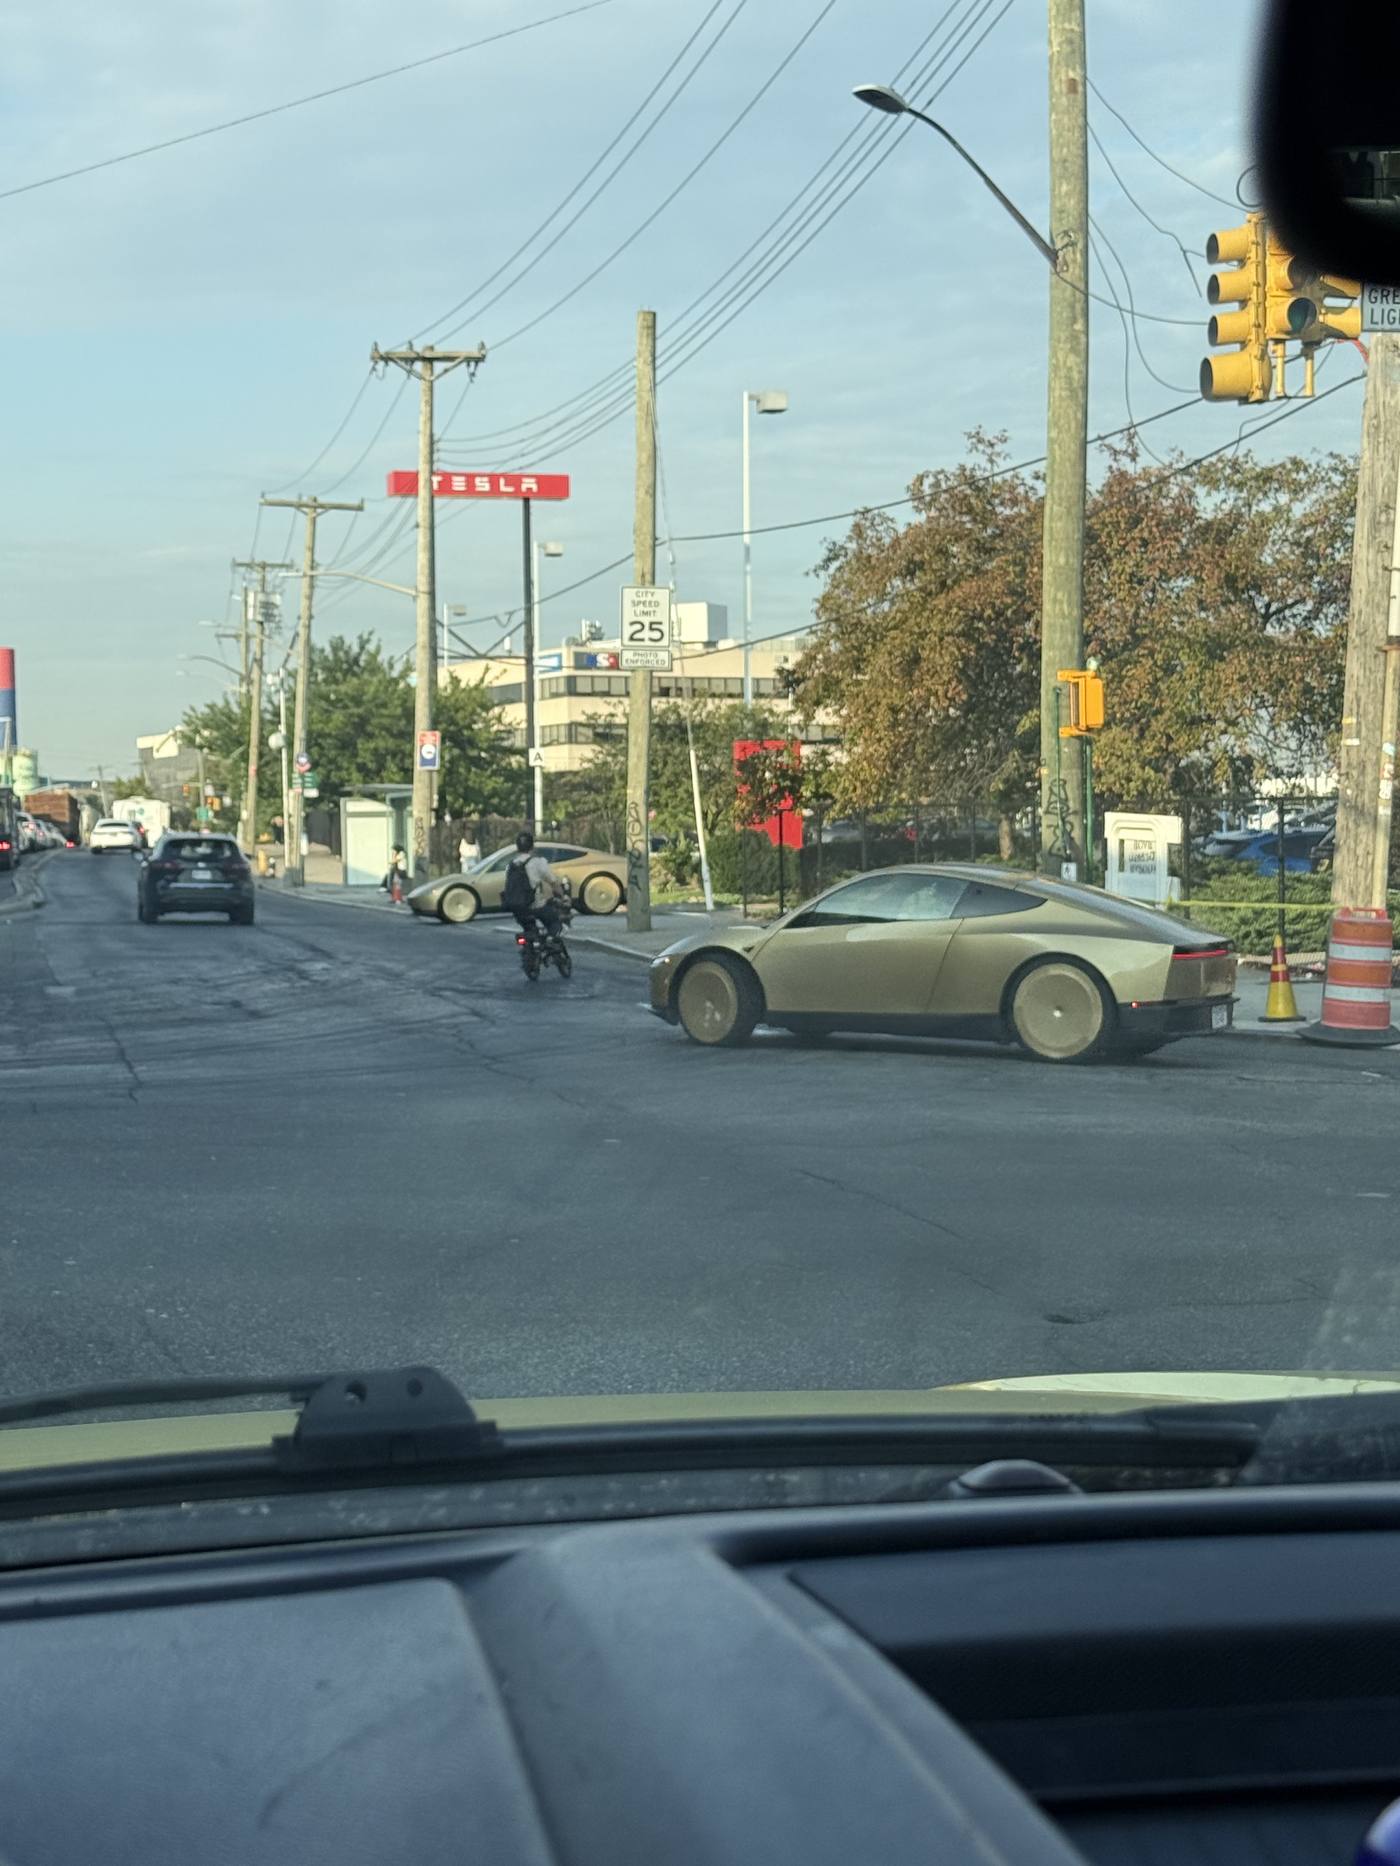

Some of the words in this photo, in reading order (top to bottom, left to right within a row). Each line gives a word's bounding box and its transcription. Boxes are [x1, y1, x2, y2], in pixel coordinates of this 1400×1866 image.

[1370, 307, 1400, 325] LIG
[431, 475, 538, 493] TESLA
[635, 590, 655, 598] CITY
[631, 600, 660, 608] SPEED
[633, 609, 657, 617] LIMIT
[628, 620, 664, 642] 25
[624, 658, 666, 666] ENFORCED
[533, 751, 543, 762] A
